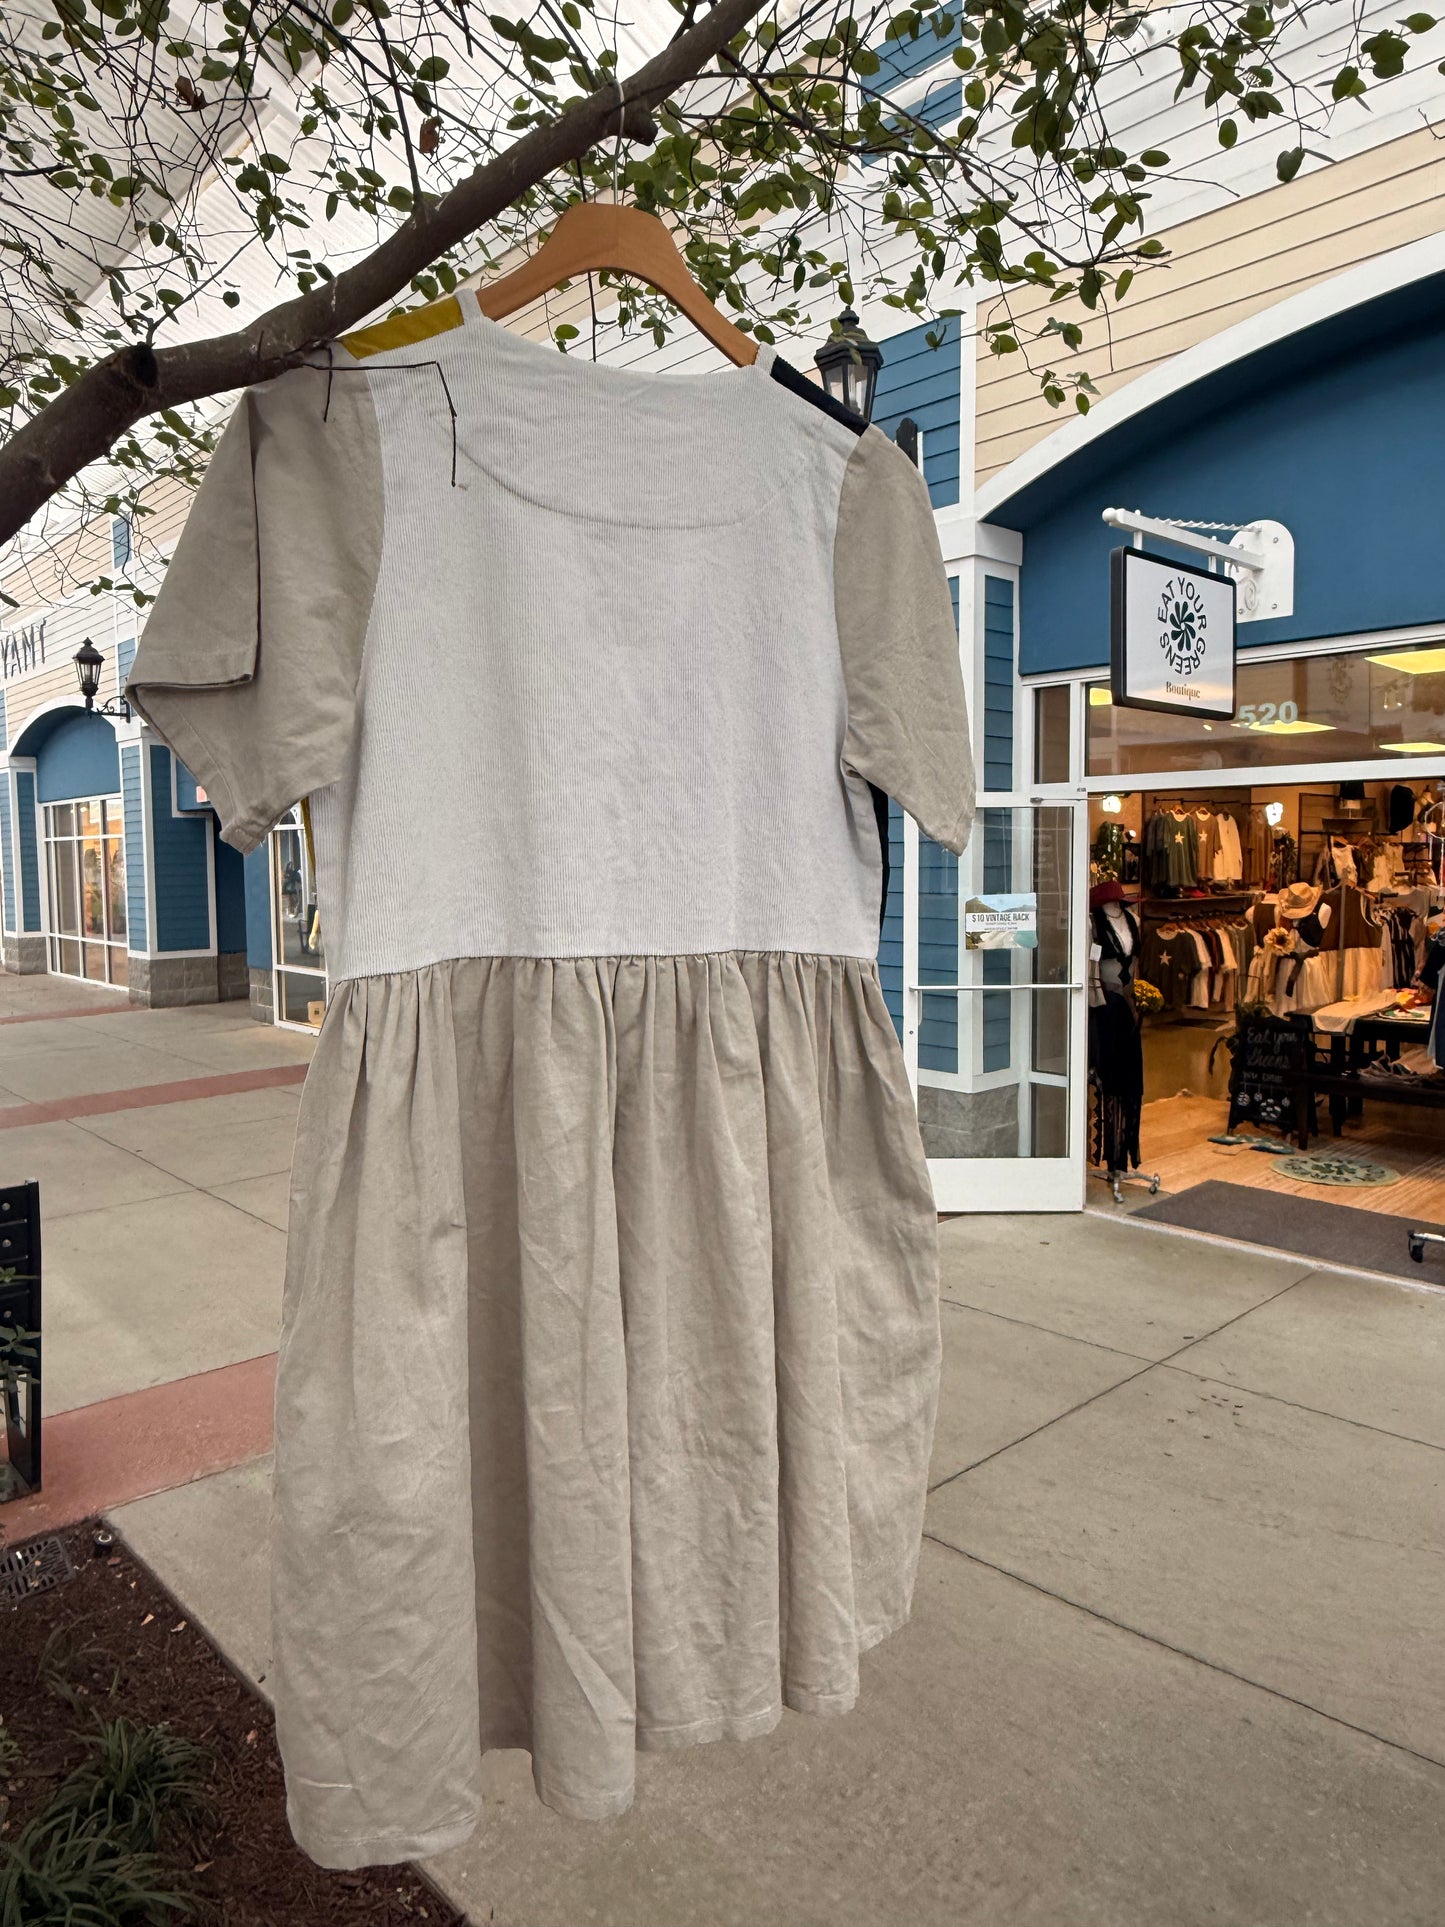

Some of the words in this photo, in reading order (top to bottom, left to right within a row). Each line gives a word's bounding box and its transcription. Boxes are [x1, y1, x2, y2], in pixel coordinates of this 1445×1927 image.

[1157, 580, 1175, 623] EAT
[1178, 576, 1207, 630] YOUR
[1160, 632, 1206, 675] GREENS
[1166, 681, 1201, 701] Boutique
[1238, 700, 1298, 728] 520
[986, 913, 1011, 922] VINTAGE
[1247, 1027, 1270, 1043] Eat
